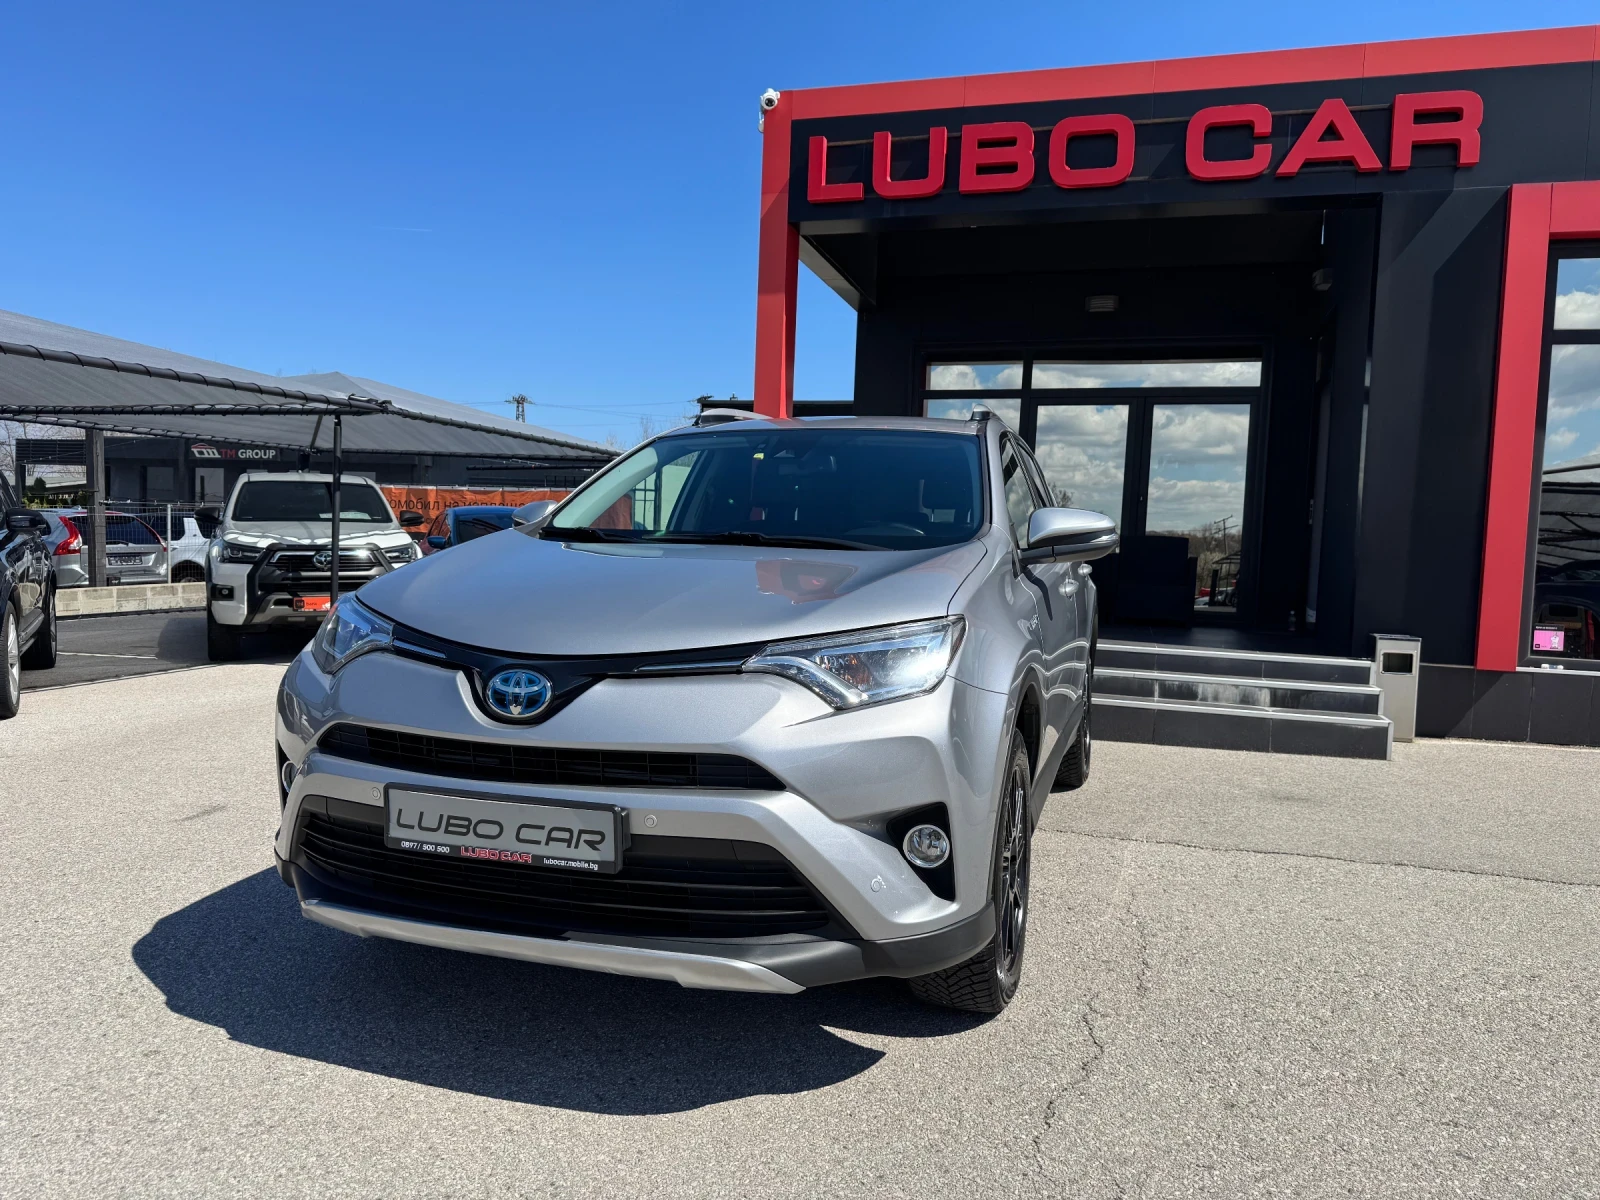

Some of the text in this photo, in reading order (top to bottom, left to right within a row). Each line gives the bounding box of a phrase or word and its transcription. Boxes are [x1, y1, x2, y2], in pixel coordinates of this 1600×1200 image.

[808, 90, 1484, 203] LUBO CAR
[220, 449, 276, 459] TM GROUP
[388, 498, 440, 510] омобил
[396, 809, 606, 852] LUBO CAR
[422, 843, 436, 852] 500
[437, 845, 450, 854] 500
[460, 846, 533, 864] LUBO CAR
[543, 858, 599, 871] lubocar.mobile.bg
